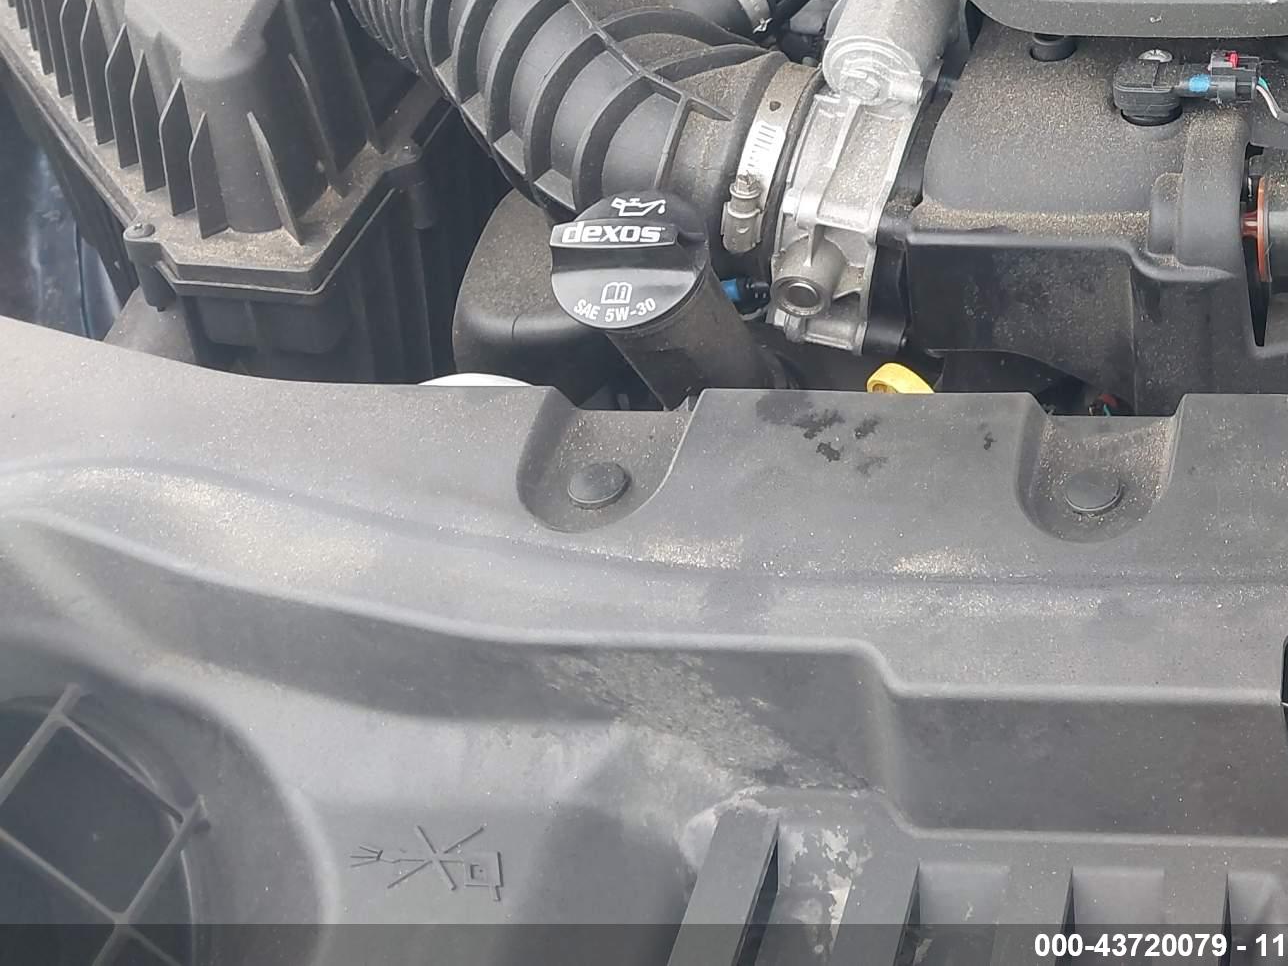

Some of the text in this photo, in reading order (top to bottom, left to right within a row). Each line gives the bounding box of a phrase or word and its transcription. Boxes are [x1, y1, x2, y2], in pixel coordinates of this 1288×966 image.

[561, 221, 663, 243] dexos
[573, 297, 656, 323] SAE 5W-30
